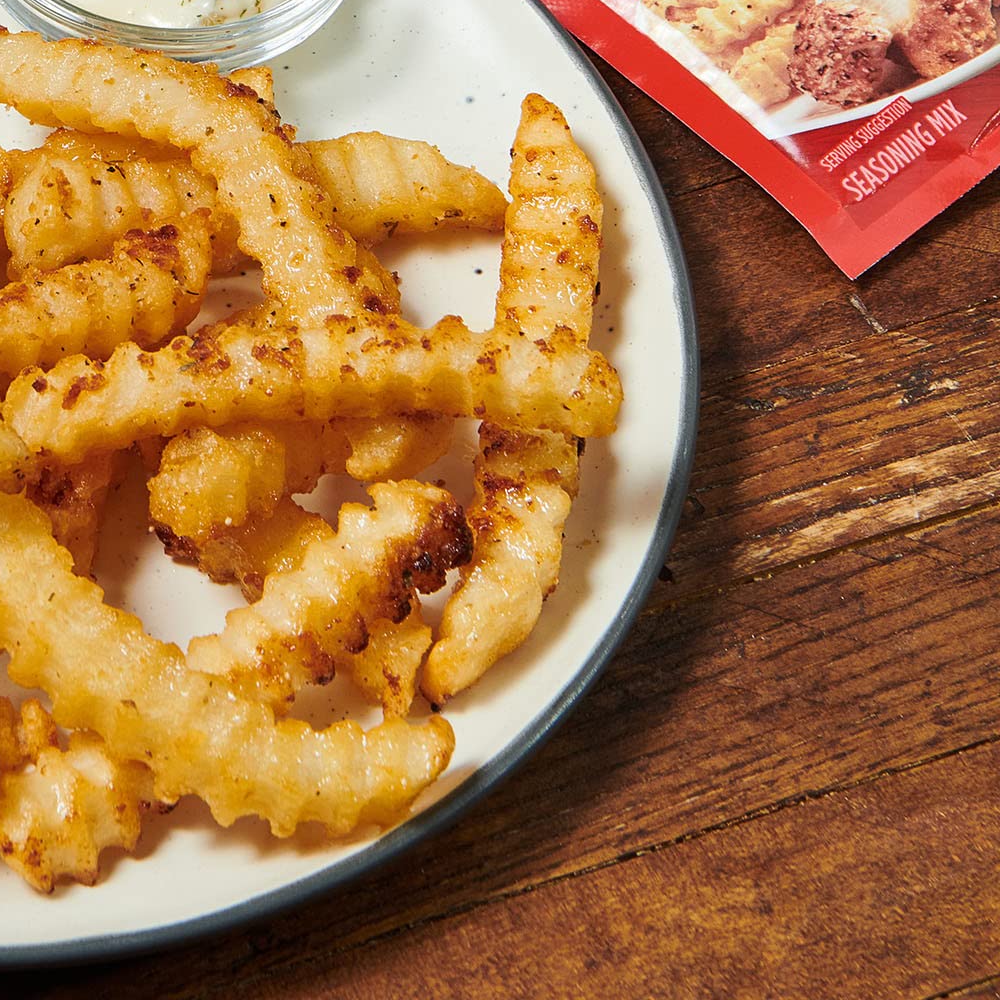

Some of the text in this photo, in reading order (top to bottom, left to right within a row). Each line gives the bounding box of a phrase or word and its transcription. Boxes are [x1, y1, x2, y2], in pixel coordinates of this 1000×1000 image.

[820, 97, 913, 172] SERVING SUGGESTION
[842, 99, 968, 202] SEASONING MIX
